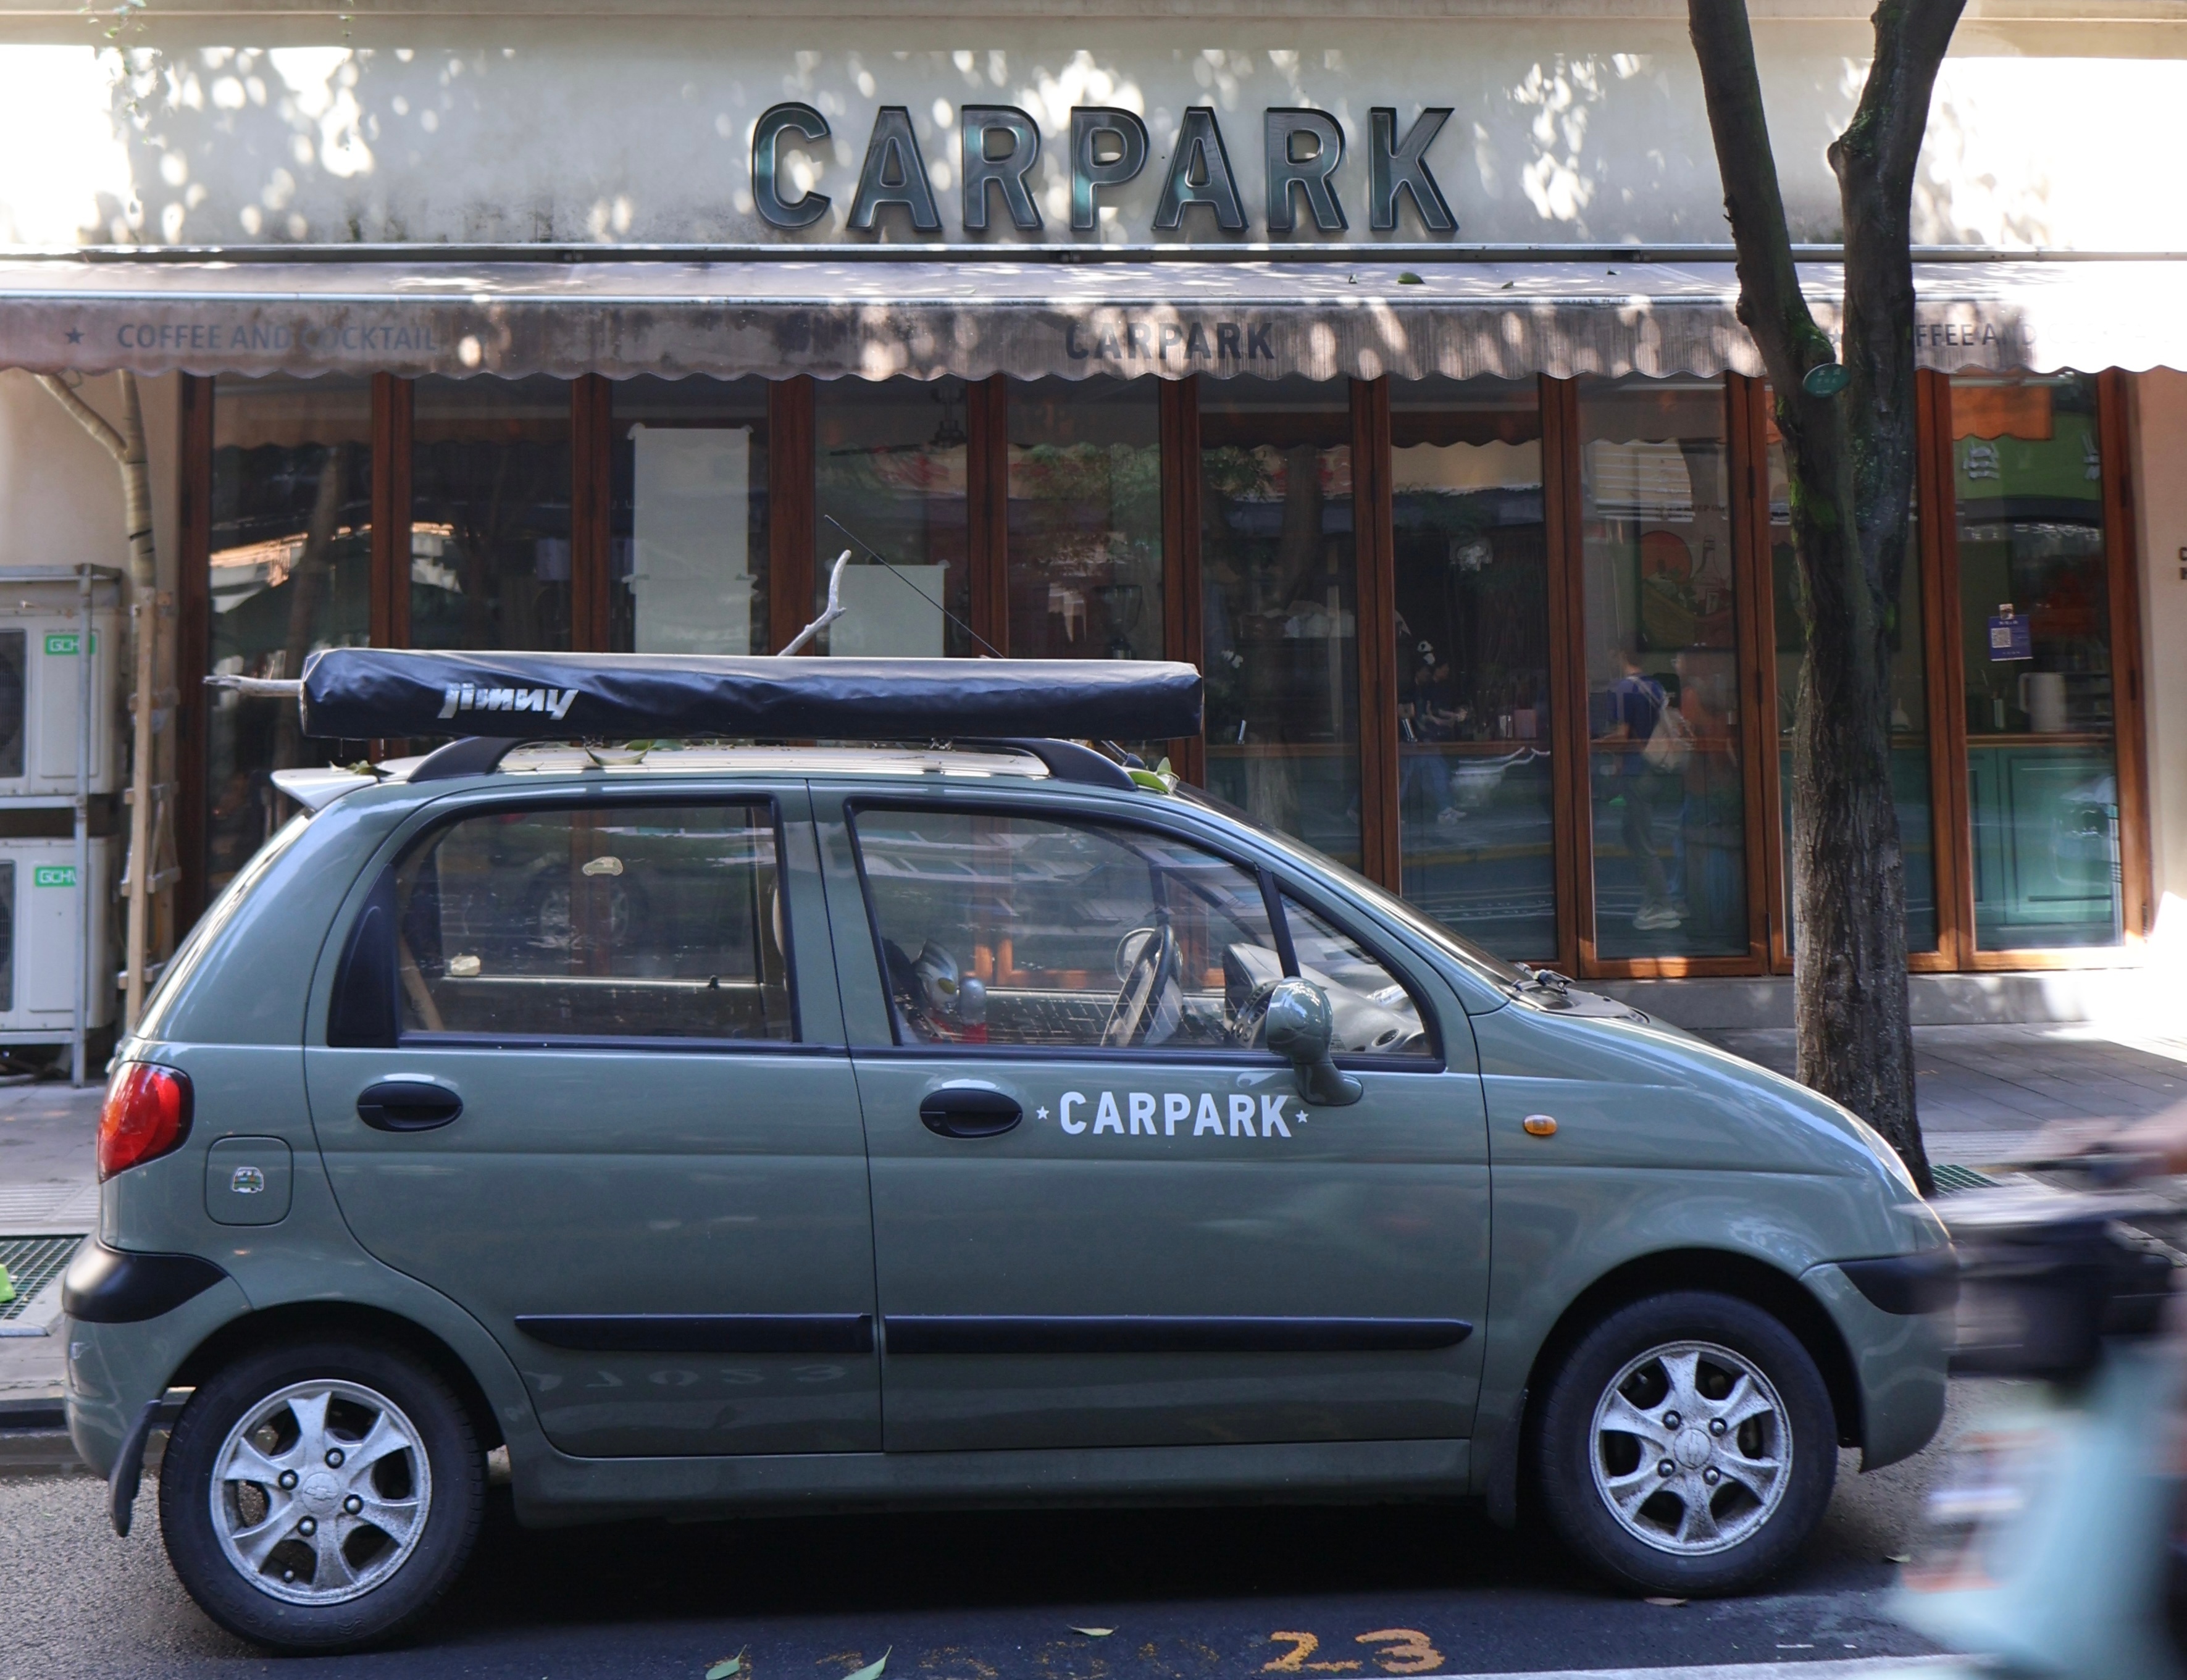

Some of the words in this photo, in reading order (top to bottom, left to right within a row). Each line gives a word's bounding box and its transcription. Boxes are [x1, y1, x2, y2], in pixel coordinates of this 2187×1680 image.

[751, 102, 1458, 232] CARPARK
[117, 323, 221, 349] COFFEE
[229, 325, 291, 350] AND
[299, 325, 437, 351] COCKTAIL
[1065, 321, 1275, 361] CARPARK
[1915, 324, 1975, 347] FFEE
[1060, 1091, 1292, 1138] CARPARK
